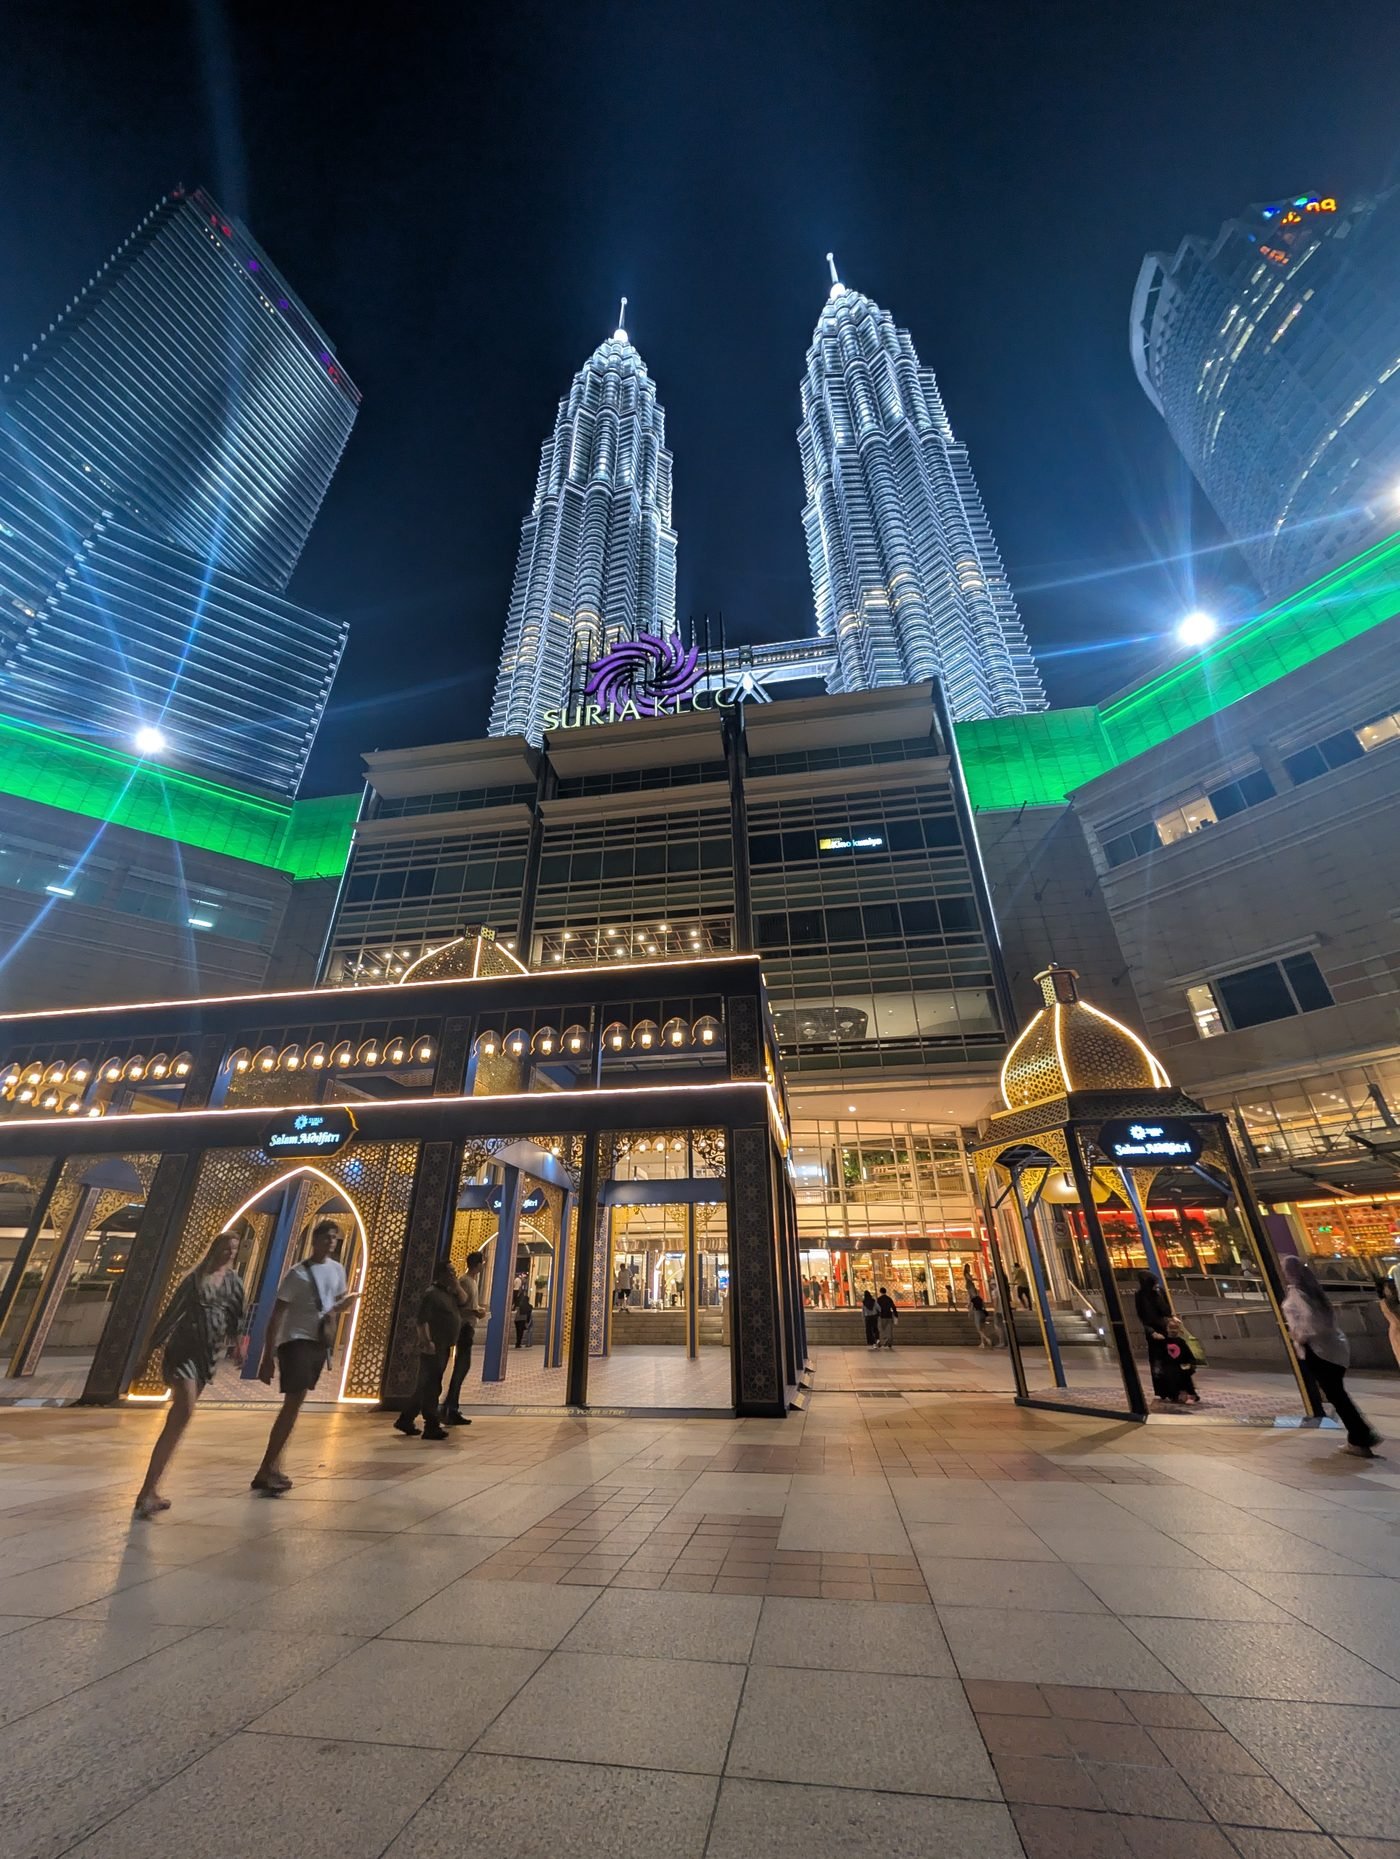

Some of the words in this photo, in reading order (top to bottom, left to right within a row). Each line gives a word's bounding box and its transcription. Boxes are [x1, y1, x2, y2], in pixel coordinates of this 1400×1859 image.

[542, 699, 641, 732] SURIA
[654, 687, 736, 717] KLCC
[269, 1133, 298, 1147] Salam
